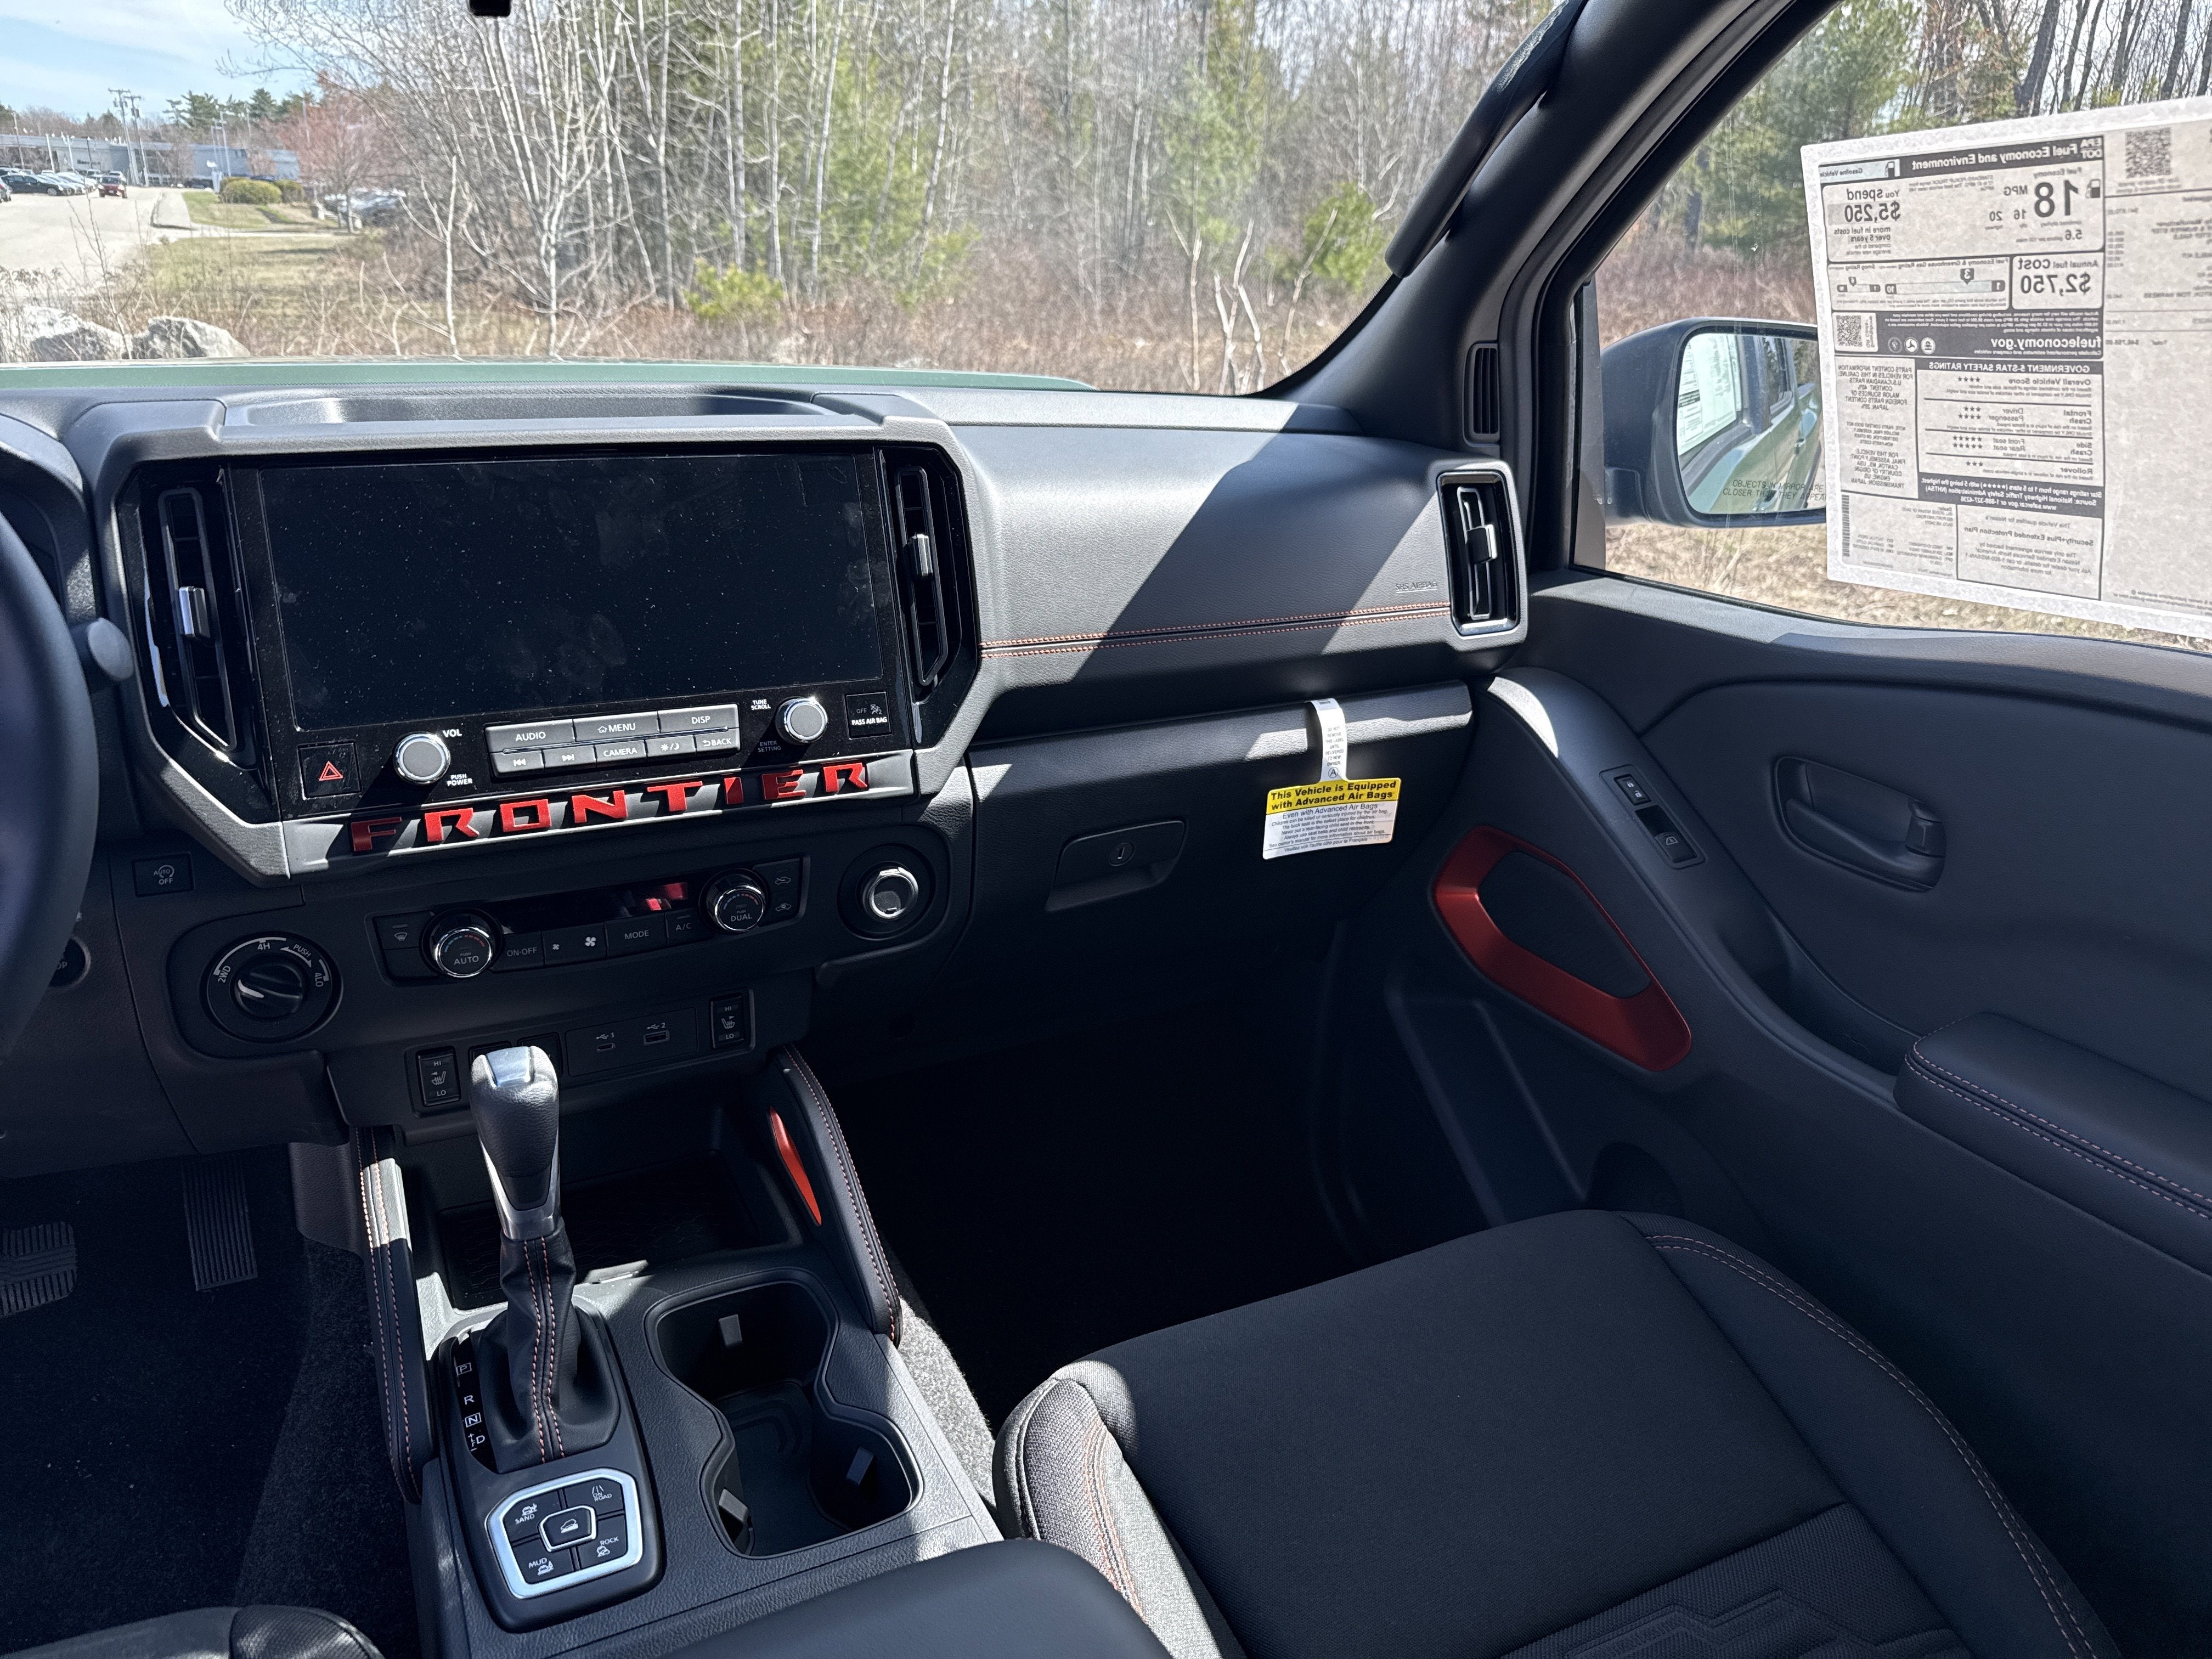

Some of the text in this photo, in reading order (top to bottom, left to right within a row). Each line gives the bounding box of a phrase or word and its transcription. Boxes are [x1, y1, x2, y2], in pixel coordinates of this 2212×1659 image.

[1733, 479, 1766, 488] OBJECTS
[1723, 488, 1752, 496] CLOSER
[691, 715, 710, 724] DISP
[608, 723, 636, 733] MENU
[442, 729, 462, 738] VOL
[516, 731, 546, 742] AUDIO
[712, 738, 732, 746] BACK
[603, 747, 637, 757] CAMERA
[1271, 791, 1291, 800] This
[1295, 786, 1331, 796] Vehicle
[1347, 781, 1396, 791] Equipped
[1272, 800, 1292, 810] with
[1295, 793, 1345, 806] Advanced
[351, 763, 868, 852] FRONTIER
[1314, 804, 1347, 814] Advanced
[675, 923, 692, 931] A/C
[624, 930, 650, 940] MODE
[293, 944, 311, 957] PUSH
[506, 947, 538, 957] ON-OFF
[454, 956, 479, 966] AUTO
[217, 966, 231, 983] 2WD
[314, 972, 324, 987] 4LO
[460, 1365, 467, 1373] P
[464, 1395, 475, 1406] R
[469, 1415, 478, 1424] N
[476, 1435, 485, 1444] D
[594, 1493, 612, 1502] ROAD
[515, 1514, 535, 1524] SAND
[600, 1537, 619, 1545] ROCK
[528, 1558, 547, 1568] MUD
